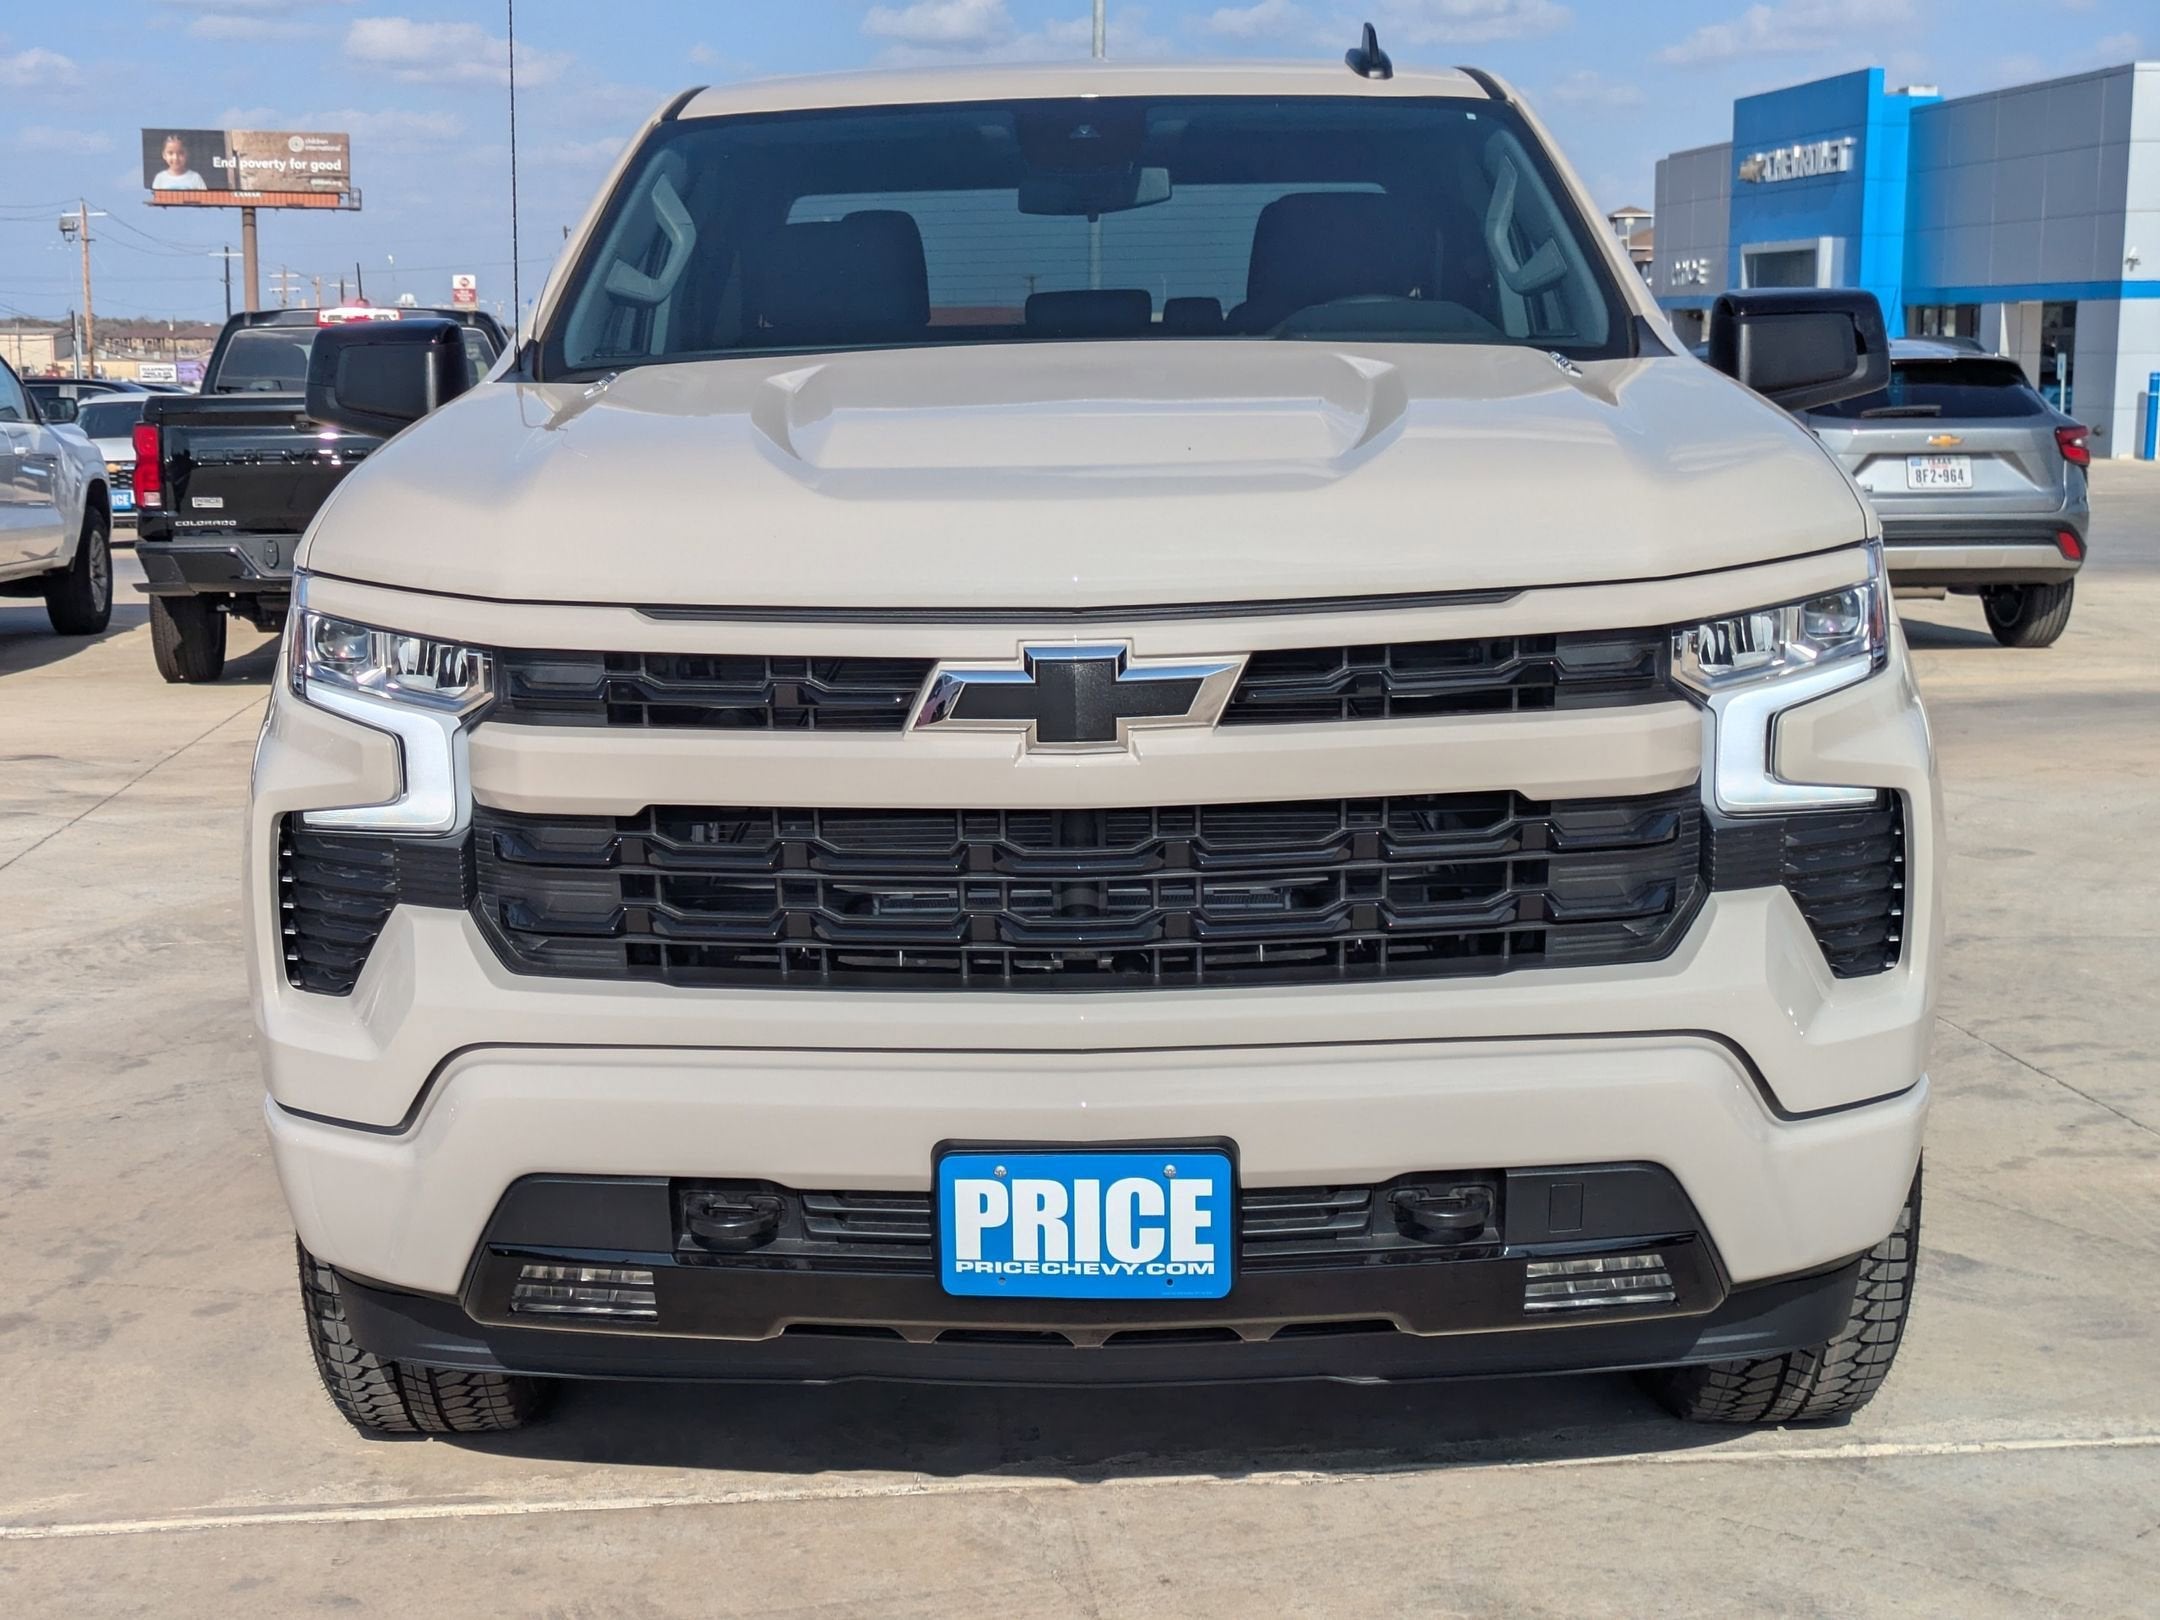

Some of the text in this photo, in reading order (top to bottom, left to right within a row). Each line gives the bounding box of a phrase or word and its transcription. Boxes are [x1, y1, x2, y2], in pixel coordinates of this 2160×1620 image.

[213, 157, 342, 173] End poverty for good
[1764, 137, 1857, 182] CHEVROLET
[112, 494, 130, 507] ICE
[175, 519, 237, 527] COLORADO
[954, 1177, 1215, 1263] PRICE
[956, 1260, 1215, 1276] PRICECHEVY.COM
